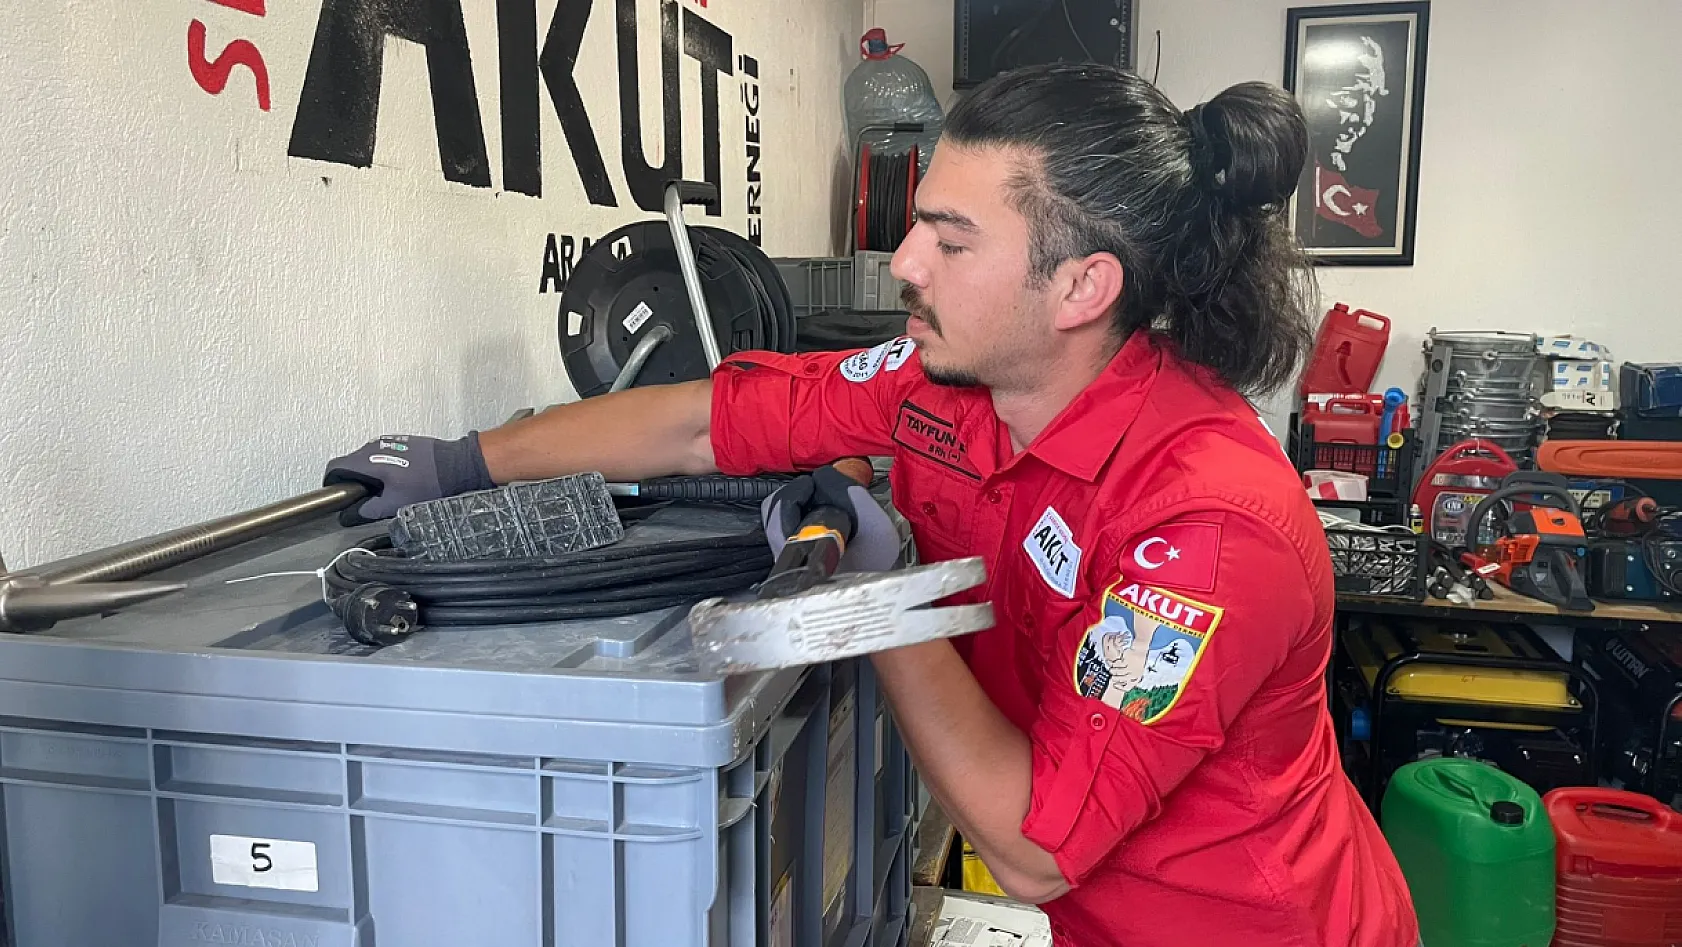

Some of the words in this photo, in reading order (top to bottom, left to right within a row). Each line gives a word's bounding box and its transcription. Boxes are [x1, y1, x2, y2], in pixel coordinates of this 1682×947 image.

[187, 0, 271, 112] S
[288, 0, 734, 216] AKUT
[738, 54, 762, 248] ERNEĞİ
[905, 413, 957, 447] TAYFUN
[1118, 583, 1204, 627] AKUT
[250, 842, 273, 873] 5
